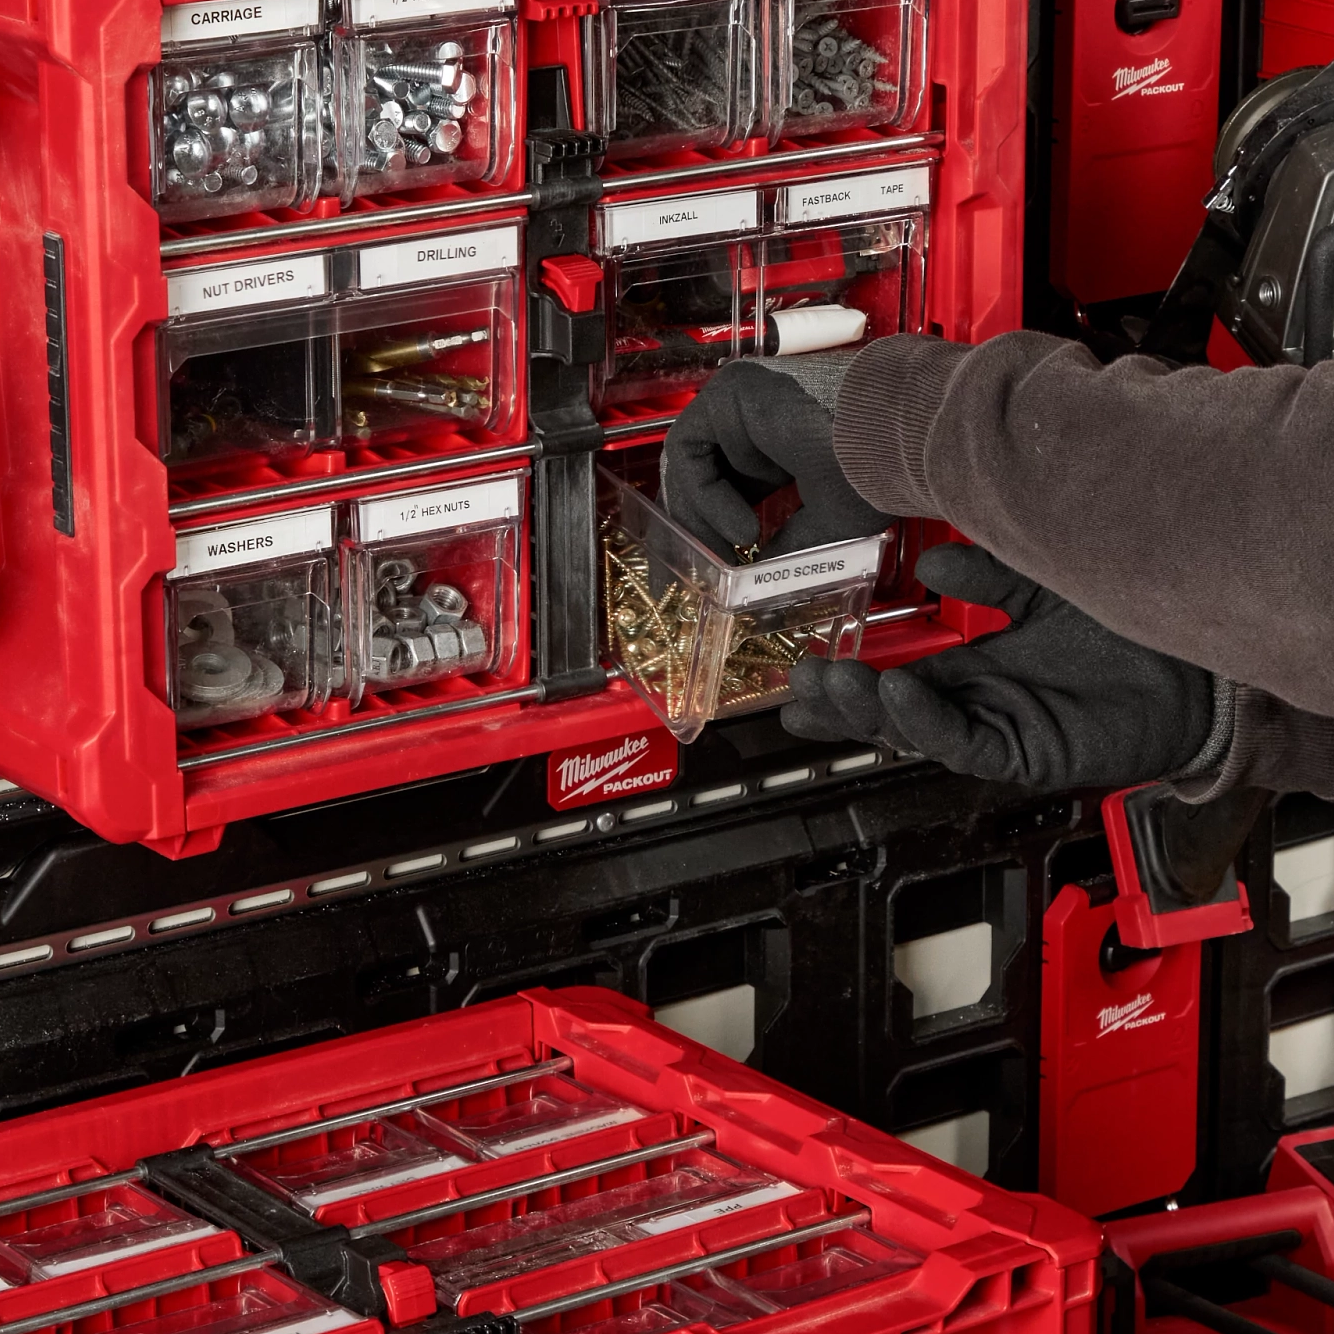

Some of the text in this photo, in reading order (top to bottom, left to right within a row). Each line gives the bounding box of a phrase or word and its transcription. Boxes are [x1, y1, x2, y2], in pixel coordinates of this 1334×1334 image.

[190, 5, 263, 25] CARRIAGE
[1111, 57, 1170, 91] Milwaukee
[1141, 82, 1184, 96] PACKOUT
[802, 183, 904, 206] FASTBACK TAPE
[658, 210, 698, 225] INKZALL
[417, 245, 477, 262] DRILLING
[203, 269, 295, 299] NUT DRIVERS
[421, 505, 443, 518] HEX
[444, 500, 470, 514] NUTS
[207, 534, 274, 556] WASHERS
[754, 560, 846, 585] WOOD SCREWS
[556, 735, 649, 791] Milwaukee
[603, 768, 672, 795] PACKOUT
[1098, 993, 1153, 1029] Milwaukee
[1124, 1012, 1166, 1031] PACKOUT
[713, 1203, 743, 1215] PPE
